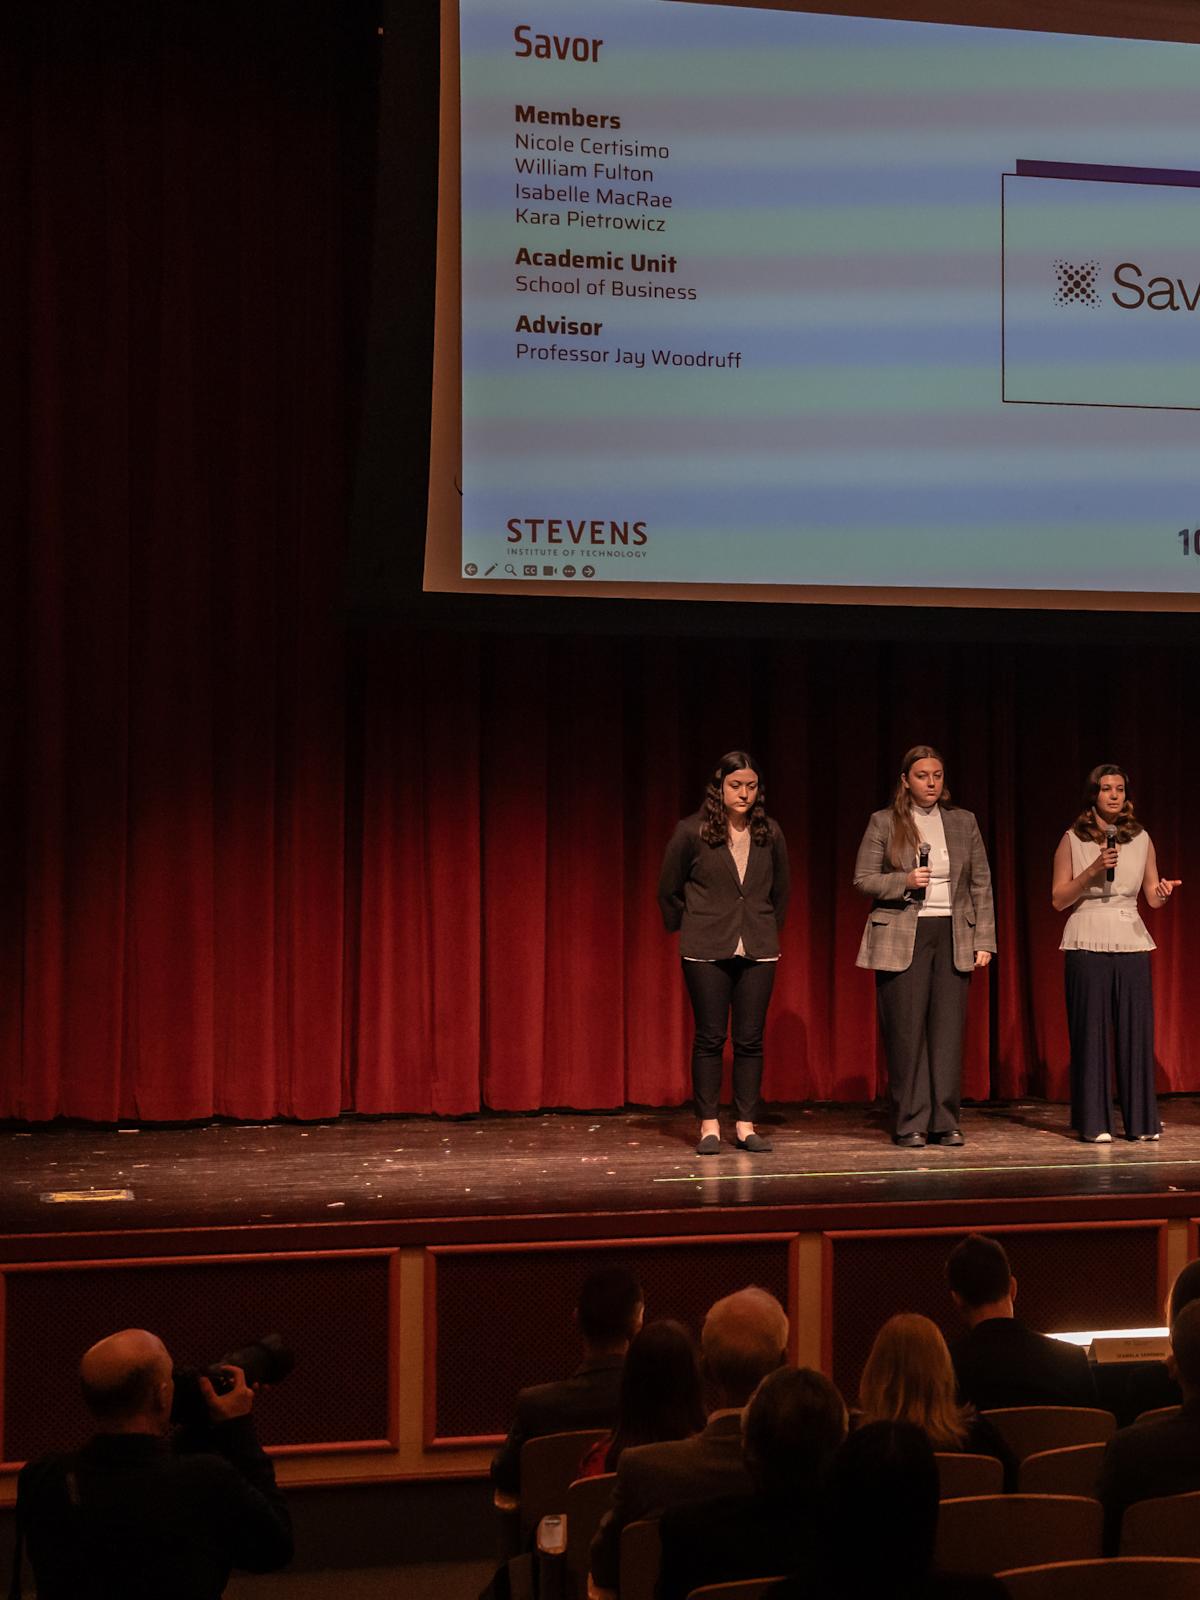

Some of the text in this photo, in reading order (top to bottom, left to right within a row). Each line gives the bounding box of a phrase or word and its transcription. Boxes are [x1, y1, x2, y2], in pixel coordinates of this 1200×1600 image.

[514, 25, 603, 62] Savor
[515, 104, 621, 129] Members
[515, 133, 669, 159] Nicole Certisimo
[515, 158, 653, 182] William Fulton
[515, 183, 672, 208] Isabelle MacRae
[515, 208, 666, 232] Kara Pietrowicz
[515, 247, 677, 273] Academic Unit
[515, 276, 697, 300] School of Business
[515, 315, 603, 336] Advisor
[516, 343, 742, 369] Professor Jay Woodruff
[507, 518, 648, 546] STEVENS
[507, 548, 647, 558] INSTITUTE OF TECHNOLOGY
